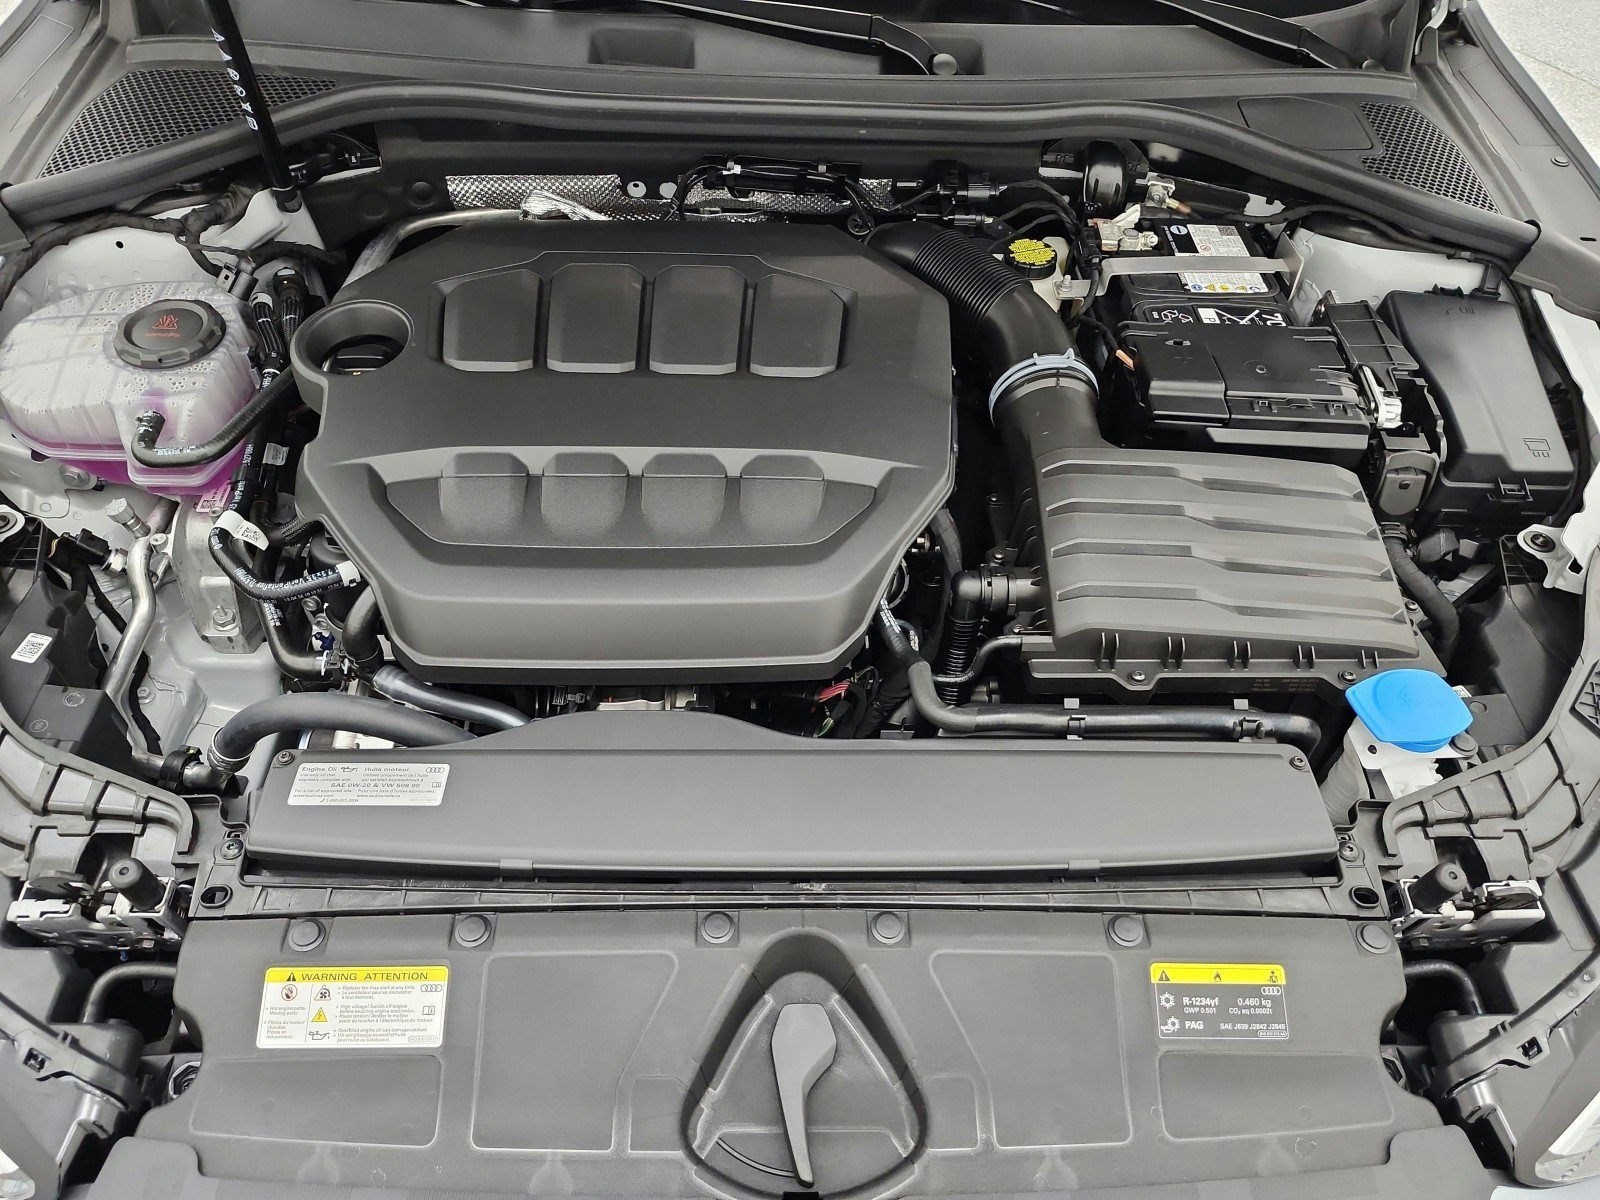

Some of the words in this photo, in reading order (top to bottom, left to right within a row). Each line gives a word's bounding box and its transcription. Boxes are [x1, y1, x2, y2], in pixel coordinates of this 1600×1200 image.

[301, 973, 358, 981] WARNING
[364, 972, 429, 980] ATTENTION
[1182, 997, 1219, 1007] R-1234yf
[1237, 998, 1260, 1006] 0.460
[1261, 998, 1272, 1007] kg
[1185, 1021, 1204, 1030] PAG
